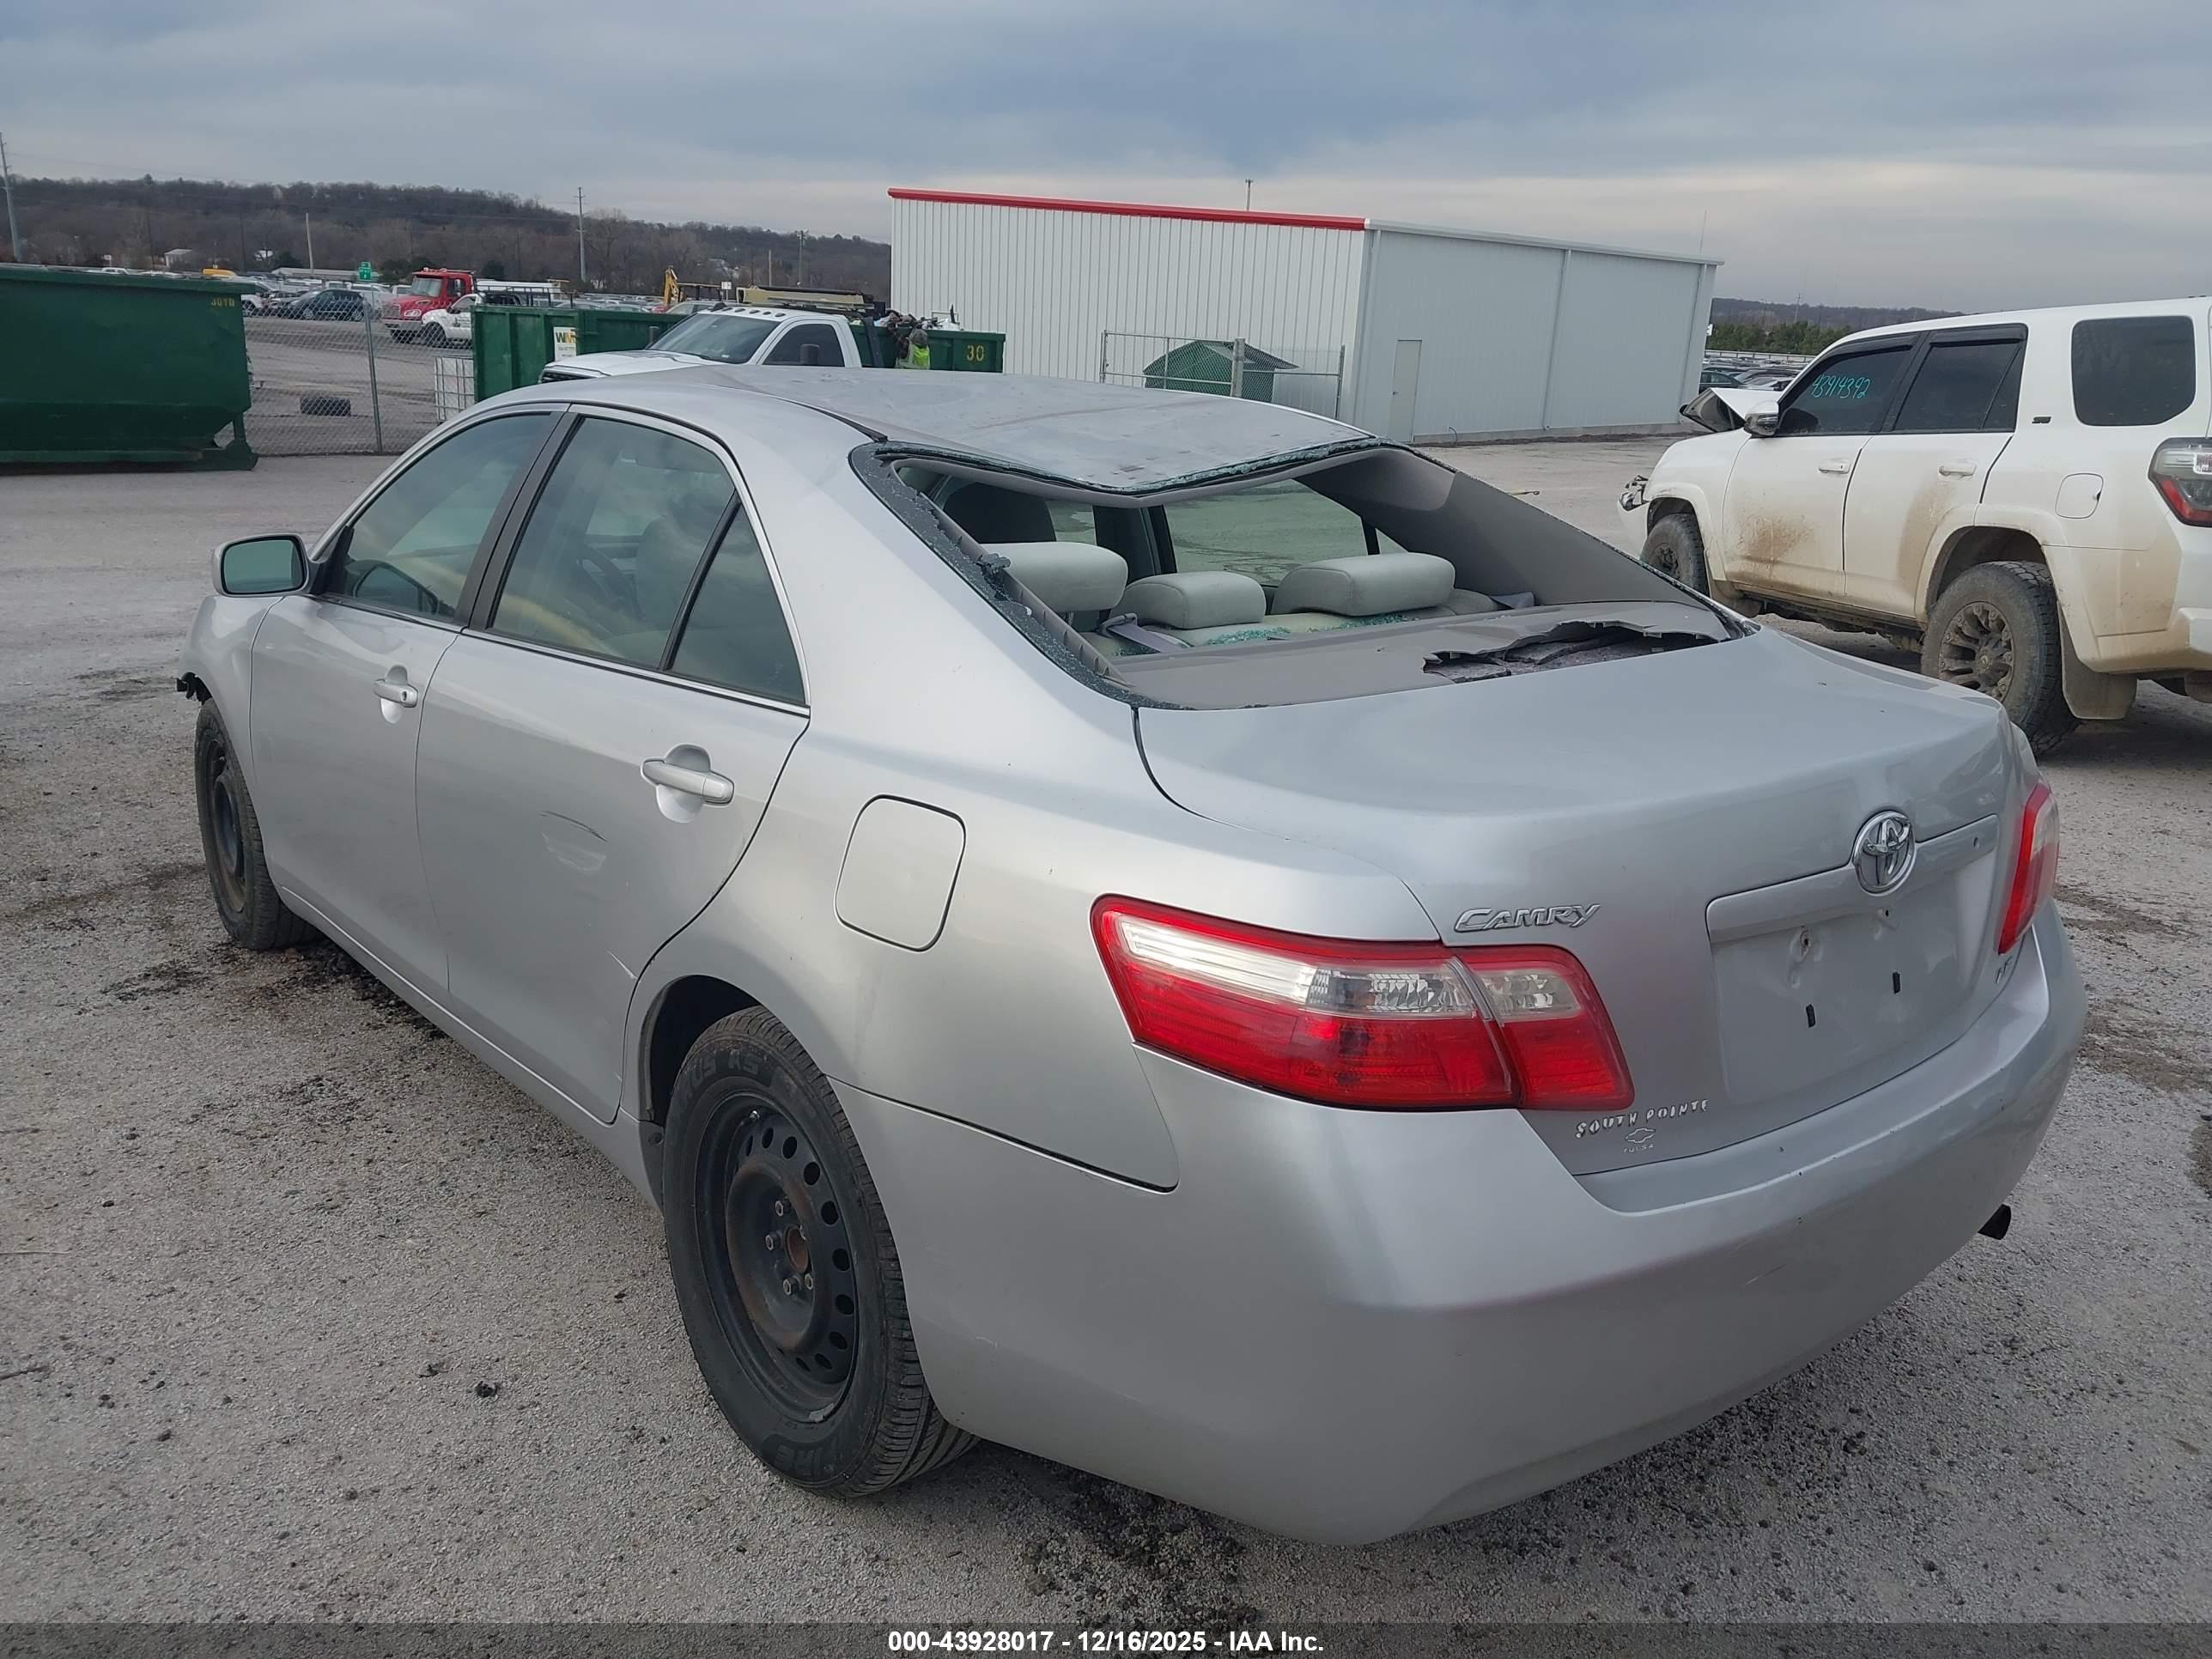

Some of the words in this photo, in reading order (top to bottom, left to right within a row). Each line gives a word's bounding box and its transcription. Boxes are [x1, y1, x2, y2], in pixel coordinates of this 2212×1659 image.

[966, 344, 985, 362] 30
[1811, 374, 1871, 398] 43914392
[1454, 902, 1601, 933] CAMRY
[1575, 1111, 1638, 1139] SOUTH
[1645, 1098, 1710, 1122] POINTE
[1623, 1143, 1655, 1154] TULSA
